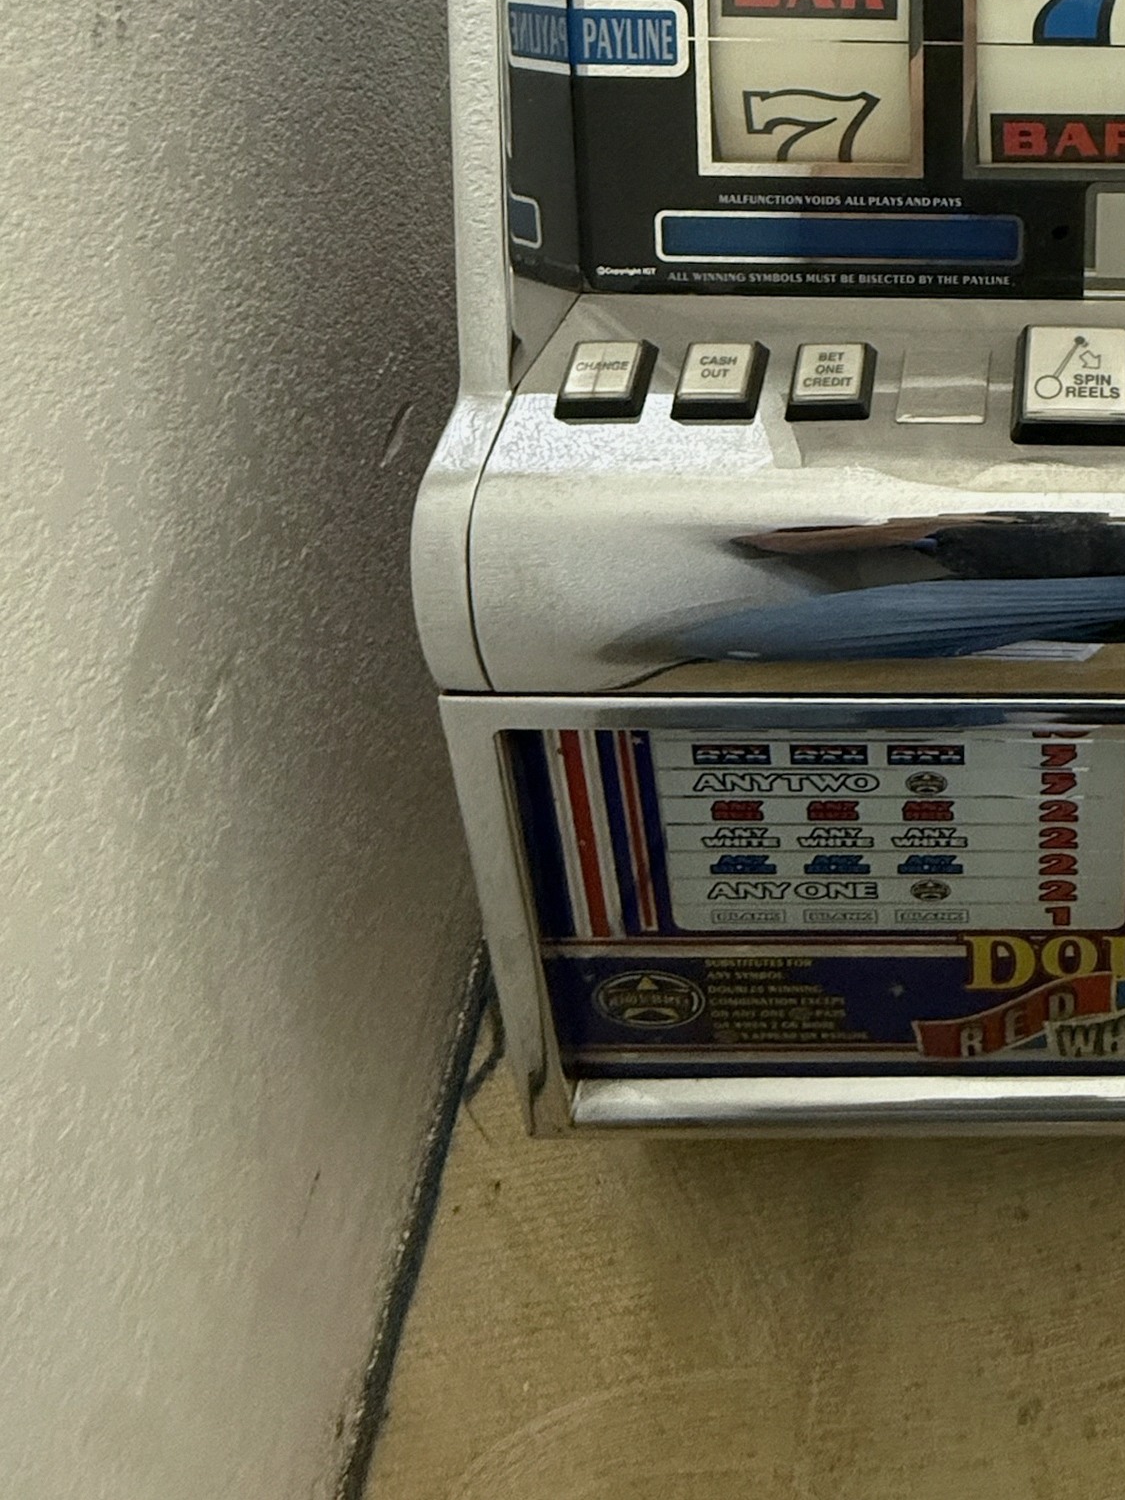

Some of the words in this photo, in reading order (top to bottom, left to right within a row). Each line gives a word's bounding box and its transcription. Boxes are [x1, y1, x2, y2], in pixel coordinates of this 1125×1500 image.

[582, 16, 675, 62] PAYLINE
[742, 88, 881, 163] 7
[719, 194, 801, 205] MALFUNCTION
[804, 195, 841, 205] VOIDS
[845, 196, 866, 206] ALL
[868, 197, 903, 207] PLAYS
[905, 197, 931, 207] AND
[933, 198, 962, 208] PAYS
[668, 272, 688, 281] ALL
[692, 273, 746, 282] WINNING
[750, 273, 801, 283] SYMBOLS
[805, 274, 836, 283] MUST
[841, 274, 855, 284] BE
[859, 275, 915, 284] BISECTED
[919, 275, 933, 285] BY
[937, 275, 959, 285] THE
[700, 355, 738, 366] CASH
[818, 352, 845, 362] BET
[575, 360, 630, 372] CHANGE
[815, 364, 845, 375] ONE
[701, 368, 731, 379] OUT
[803, 376, 854, 388] CREDIT
[1073, 374, 1112, 387] SPIN
[1065, 386, 1121, 400] REELS
[693, 773, 779, 793] ANY
[778, 773, 880, 793] TWO
[708, 882, 791, 900] ANY
[795, 882, 879, 899] ONE
[959, 987, 1076, 1057] RED
